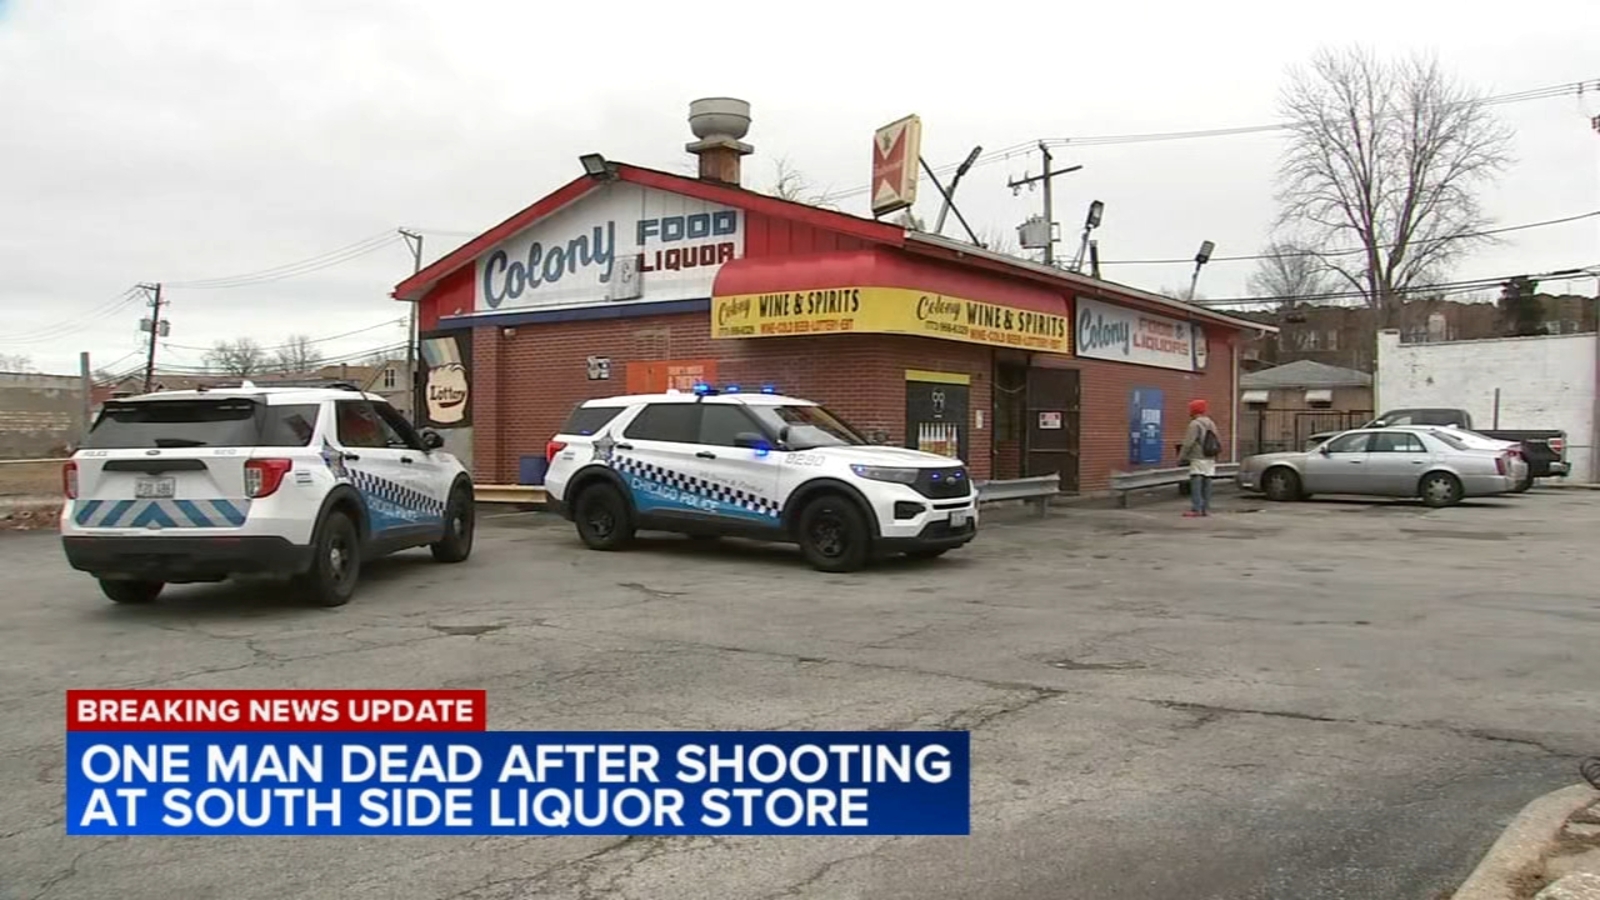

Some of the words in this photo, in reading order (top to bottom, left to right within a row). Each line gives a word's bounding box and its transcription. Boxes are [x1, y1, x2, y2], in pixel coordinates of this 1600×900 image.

[637, 210, 737, 246] FOOD
[483, 220, 615, 308] Colony
[638, 242, 735, 273] LIQUOR
[759, 294, 790, 318] WINE
[793, 293, 804, 315] &
[807, 289, 860, 315] SPIRITS
[917, 295, 961, 321] Colony
[966, 301, 1001, 329] WINE
[1004, 309, 1014, 331] &
[1018, 311, 1065, 339] SPIRITS
[1080, 307, 1129, 356] Colony
[1133, 332, 1189, 357] LIQUORS
[430, 384, 466, 405] Lottery
[631, 476, 678, 501] CHICAGO
[679, 490, 721, 514] POLICE
